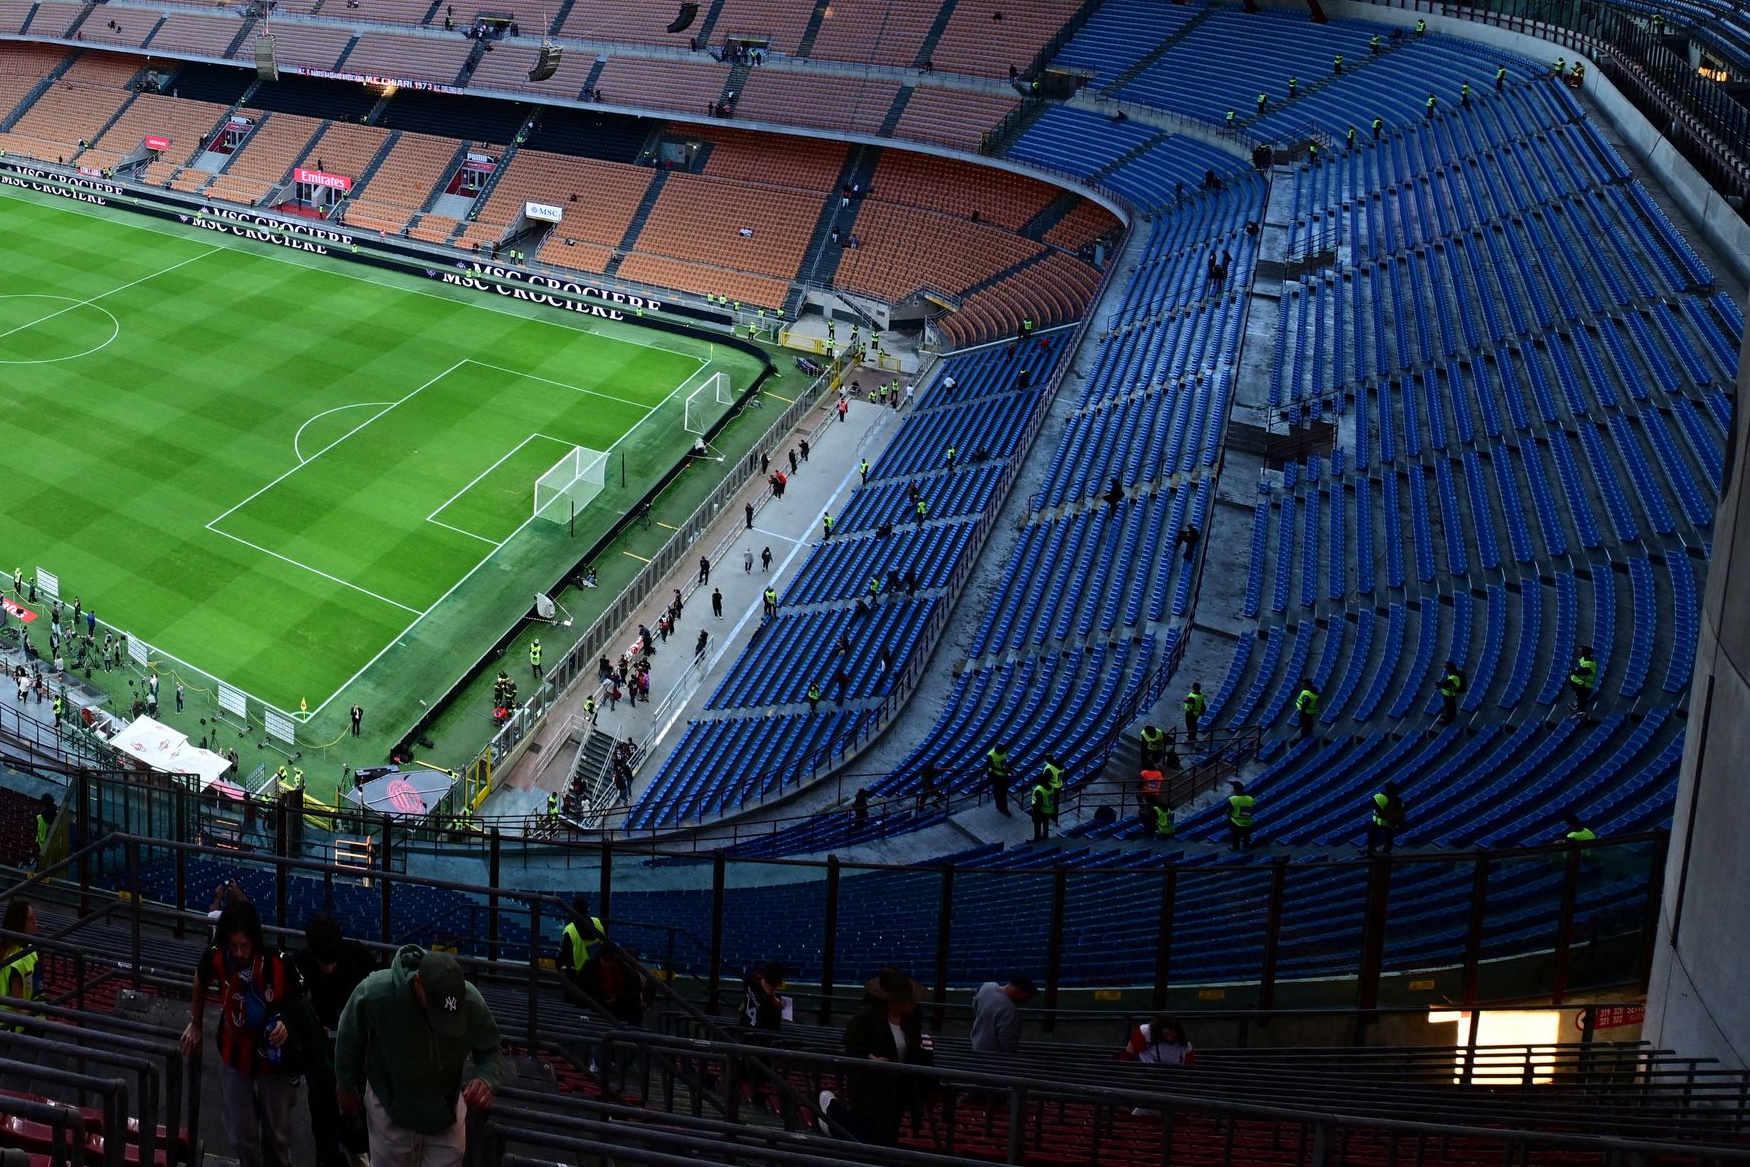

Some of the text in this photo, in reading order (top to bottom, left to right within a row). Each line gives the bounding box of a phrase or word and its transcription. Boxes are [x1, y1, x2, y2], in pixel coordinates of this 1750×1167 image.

[381, 78, 412, 88] CHIARI
[414, 82, 432, 90] 1973
[301, 172, 345, 188] Emirates
[539, 208, 559, 218] MSC
[444, 996, 458, 1011] NY
